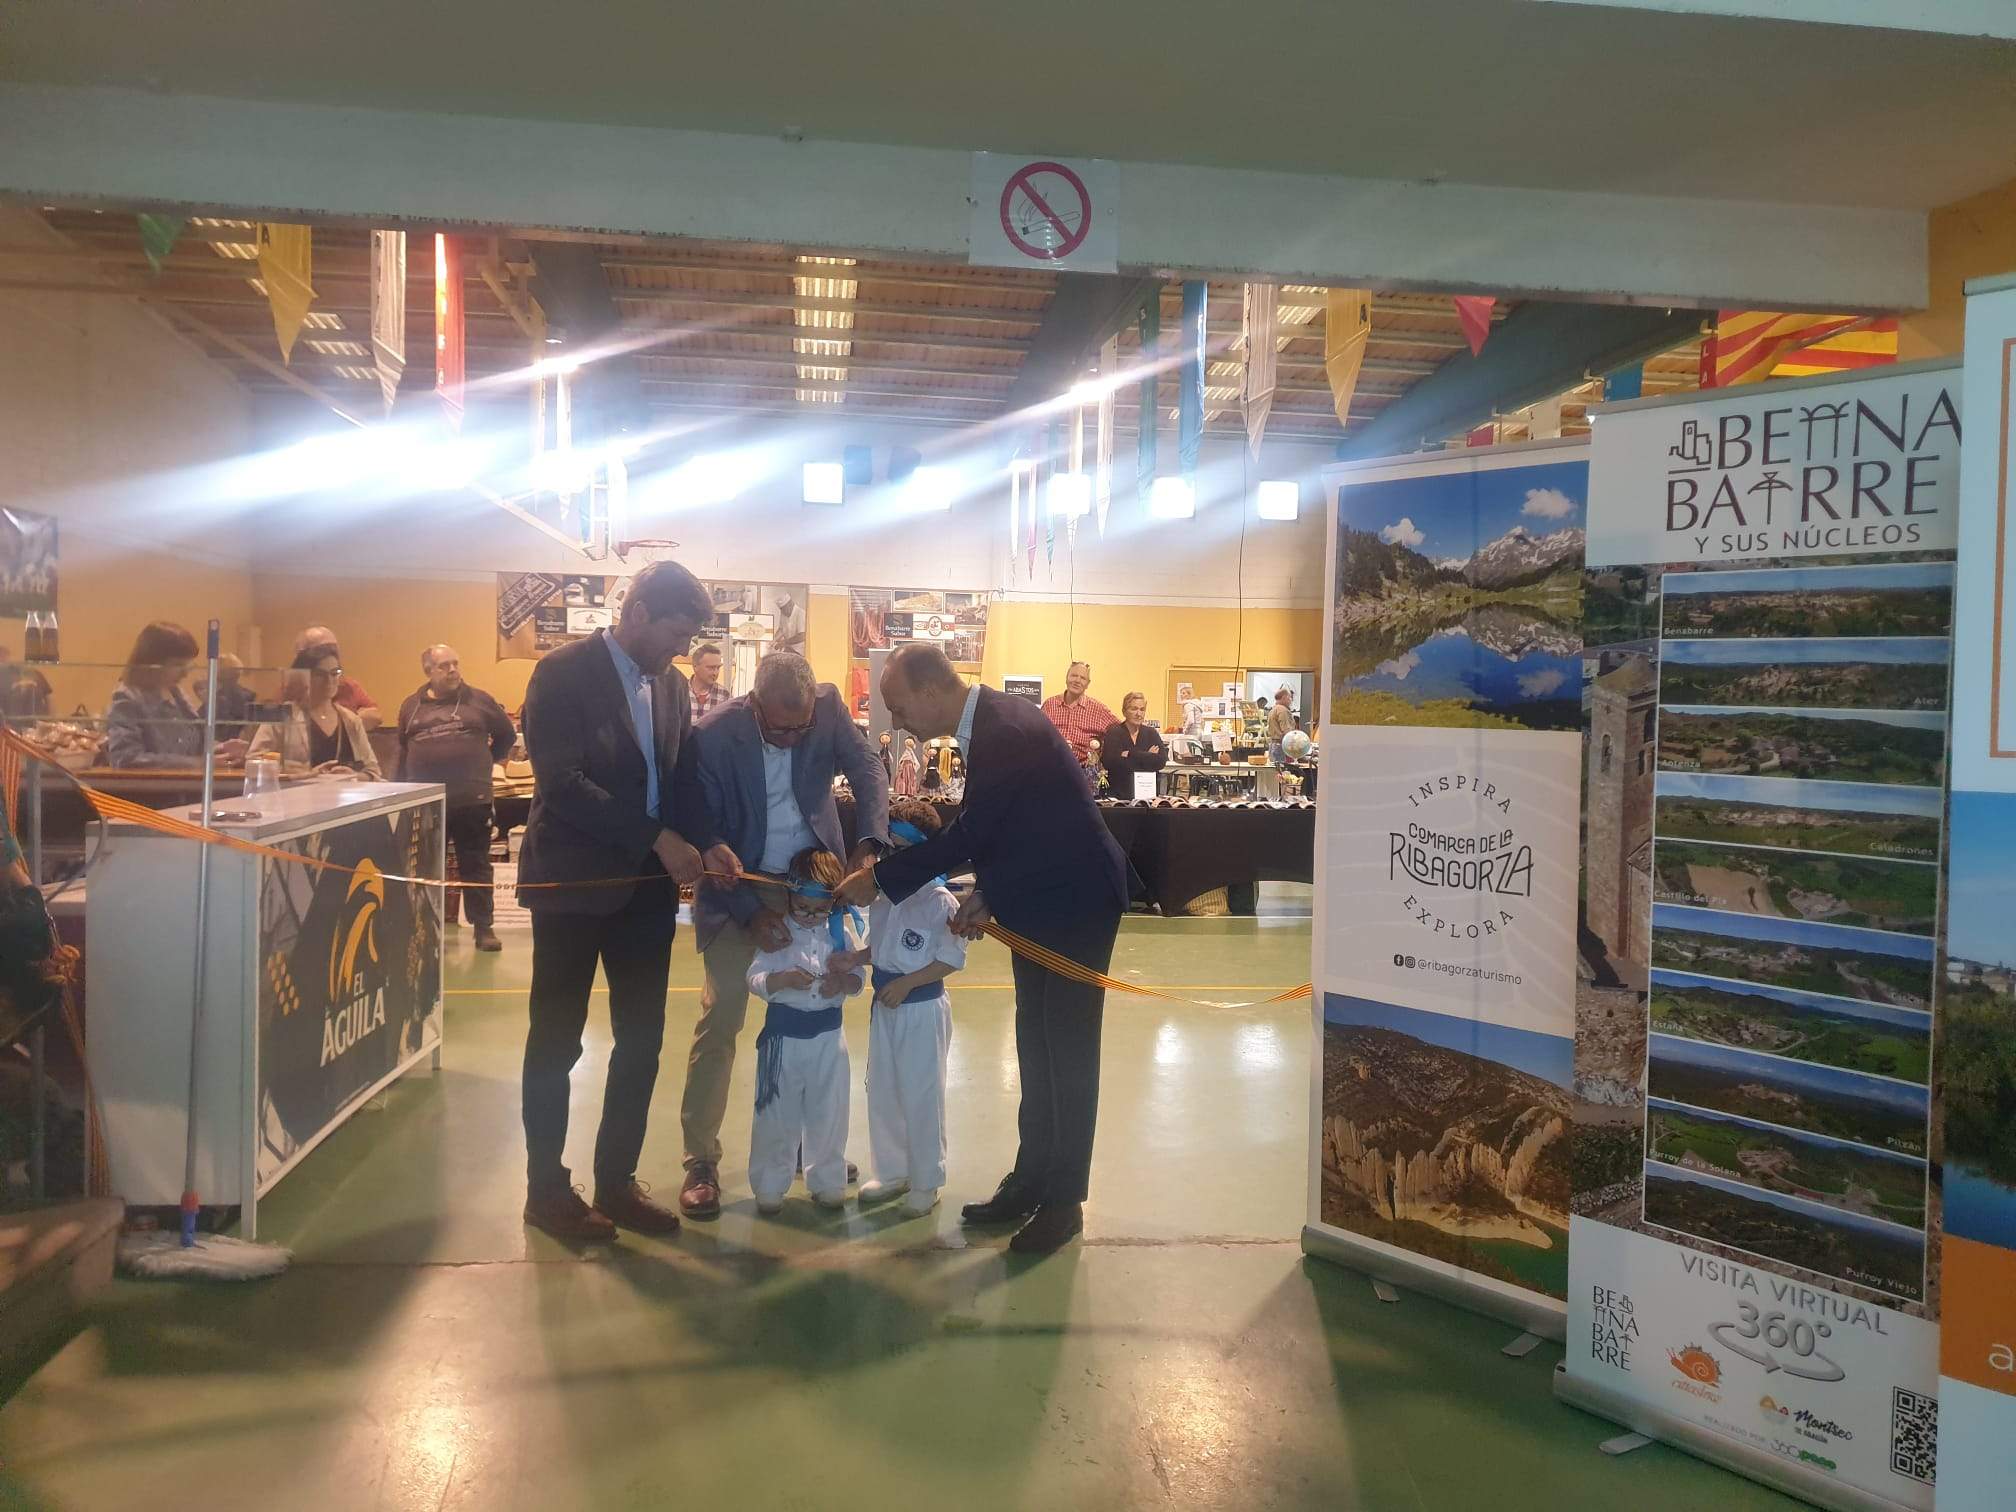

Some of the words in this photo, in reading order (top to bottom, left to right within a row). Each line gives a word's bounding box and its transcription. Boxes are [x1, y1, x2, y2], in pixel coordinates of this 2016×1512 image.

[1695, 536, 1709, 554] Y
[1721, 532, 1769, 553] SUS
[1783, 523, 1921, 550] NÚCLEOS
[1408, 775, 1513, 814] INSPIRA
[1408, 822, 1475, 854] COMARCA
[1480, 834, 1497, 854] DE
[1499, 829, 1514, 848] LA
[1389, 832, 1535, 897] RIBAGORZA
[1403, 894, 1514, 939] EXPLORA
[353, 970, 365, 997] EL
[1417, 958, 1522, 985] @ribagorzaturismo
[1680, 1251, 1759, 1295] VISITA
[1770, 1279, 1889, 1336] VIRTUAL
[1845, 1266, 1883, 1286] Purroy
[1886, 1276, 1918, 1296] Viejo
[1735, 1300, 1832, 1357] 360°
